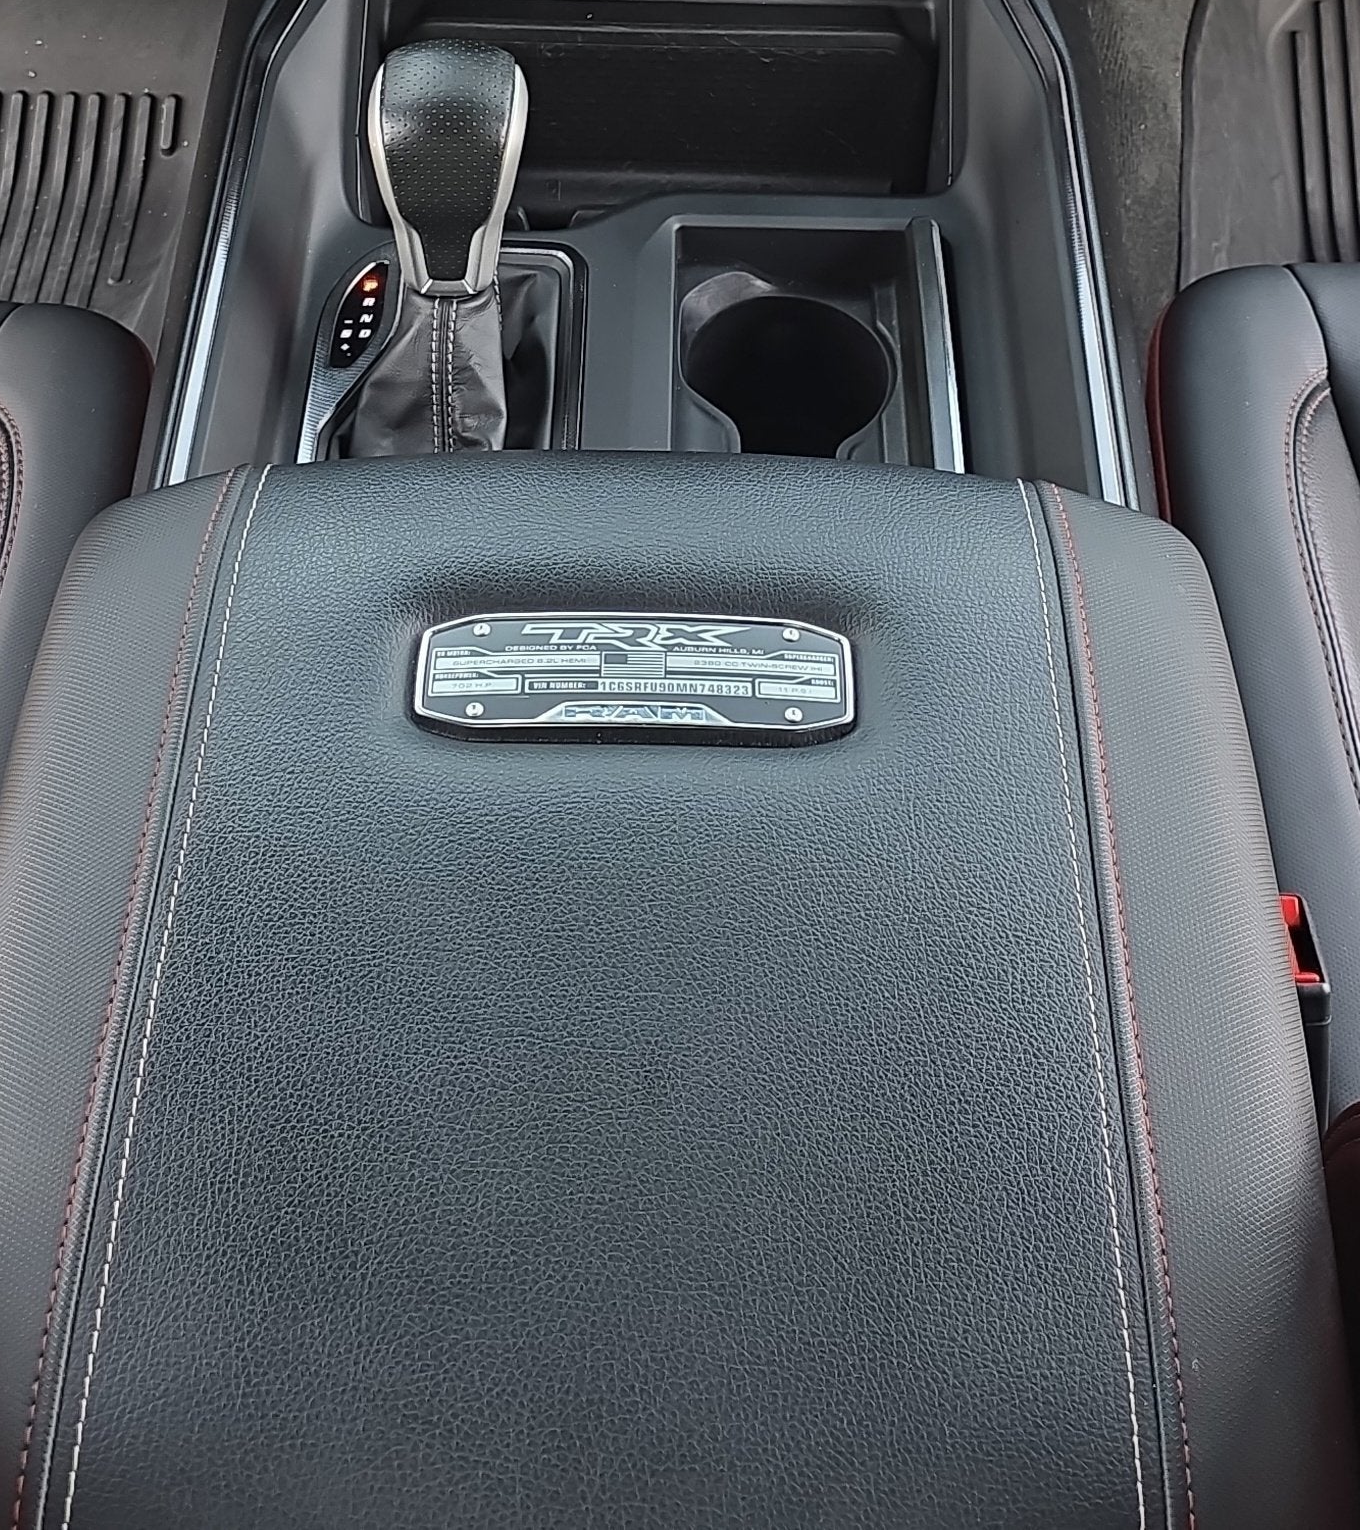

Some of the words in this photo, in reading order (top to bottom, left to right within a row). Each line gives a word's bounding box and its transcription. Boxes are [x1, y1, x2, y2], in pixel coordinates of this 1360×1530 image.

[359, 313, 374, 322] N
[358, 329, 372, 338] D
[521, 623, 752, 650] TRX
[673, 646, 716, 654] AUBURN
[718, 647, 750, 656] HILLS,
